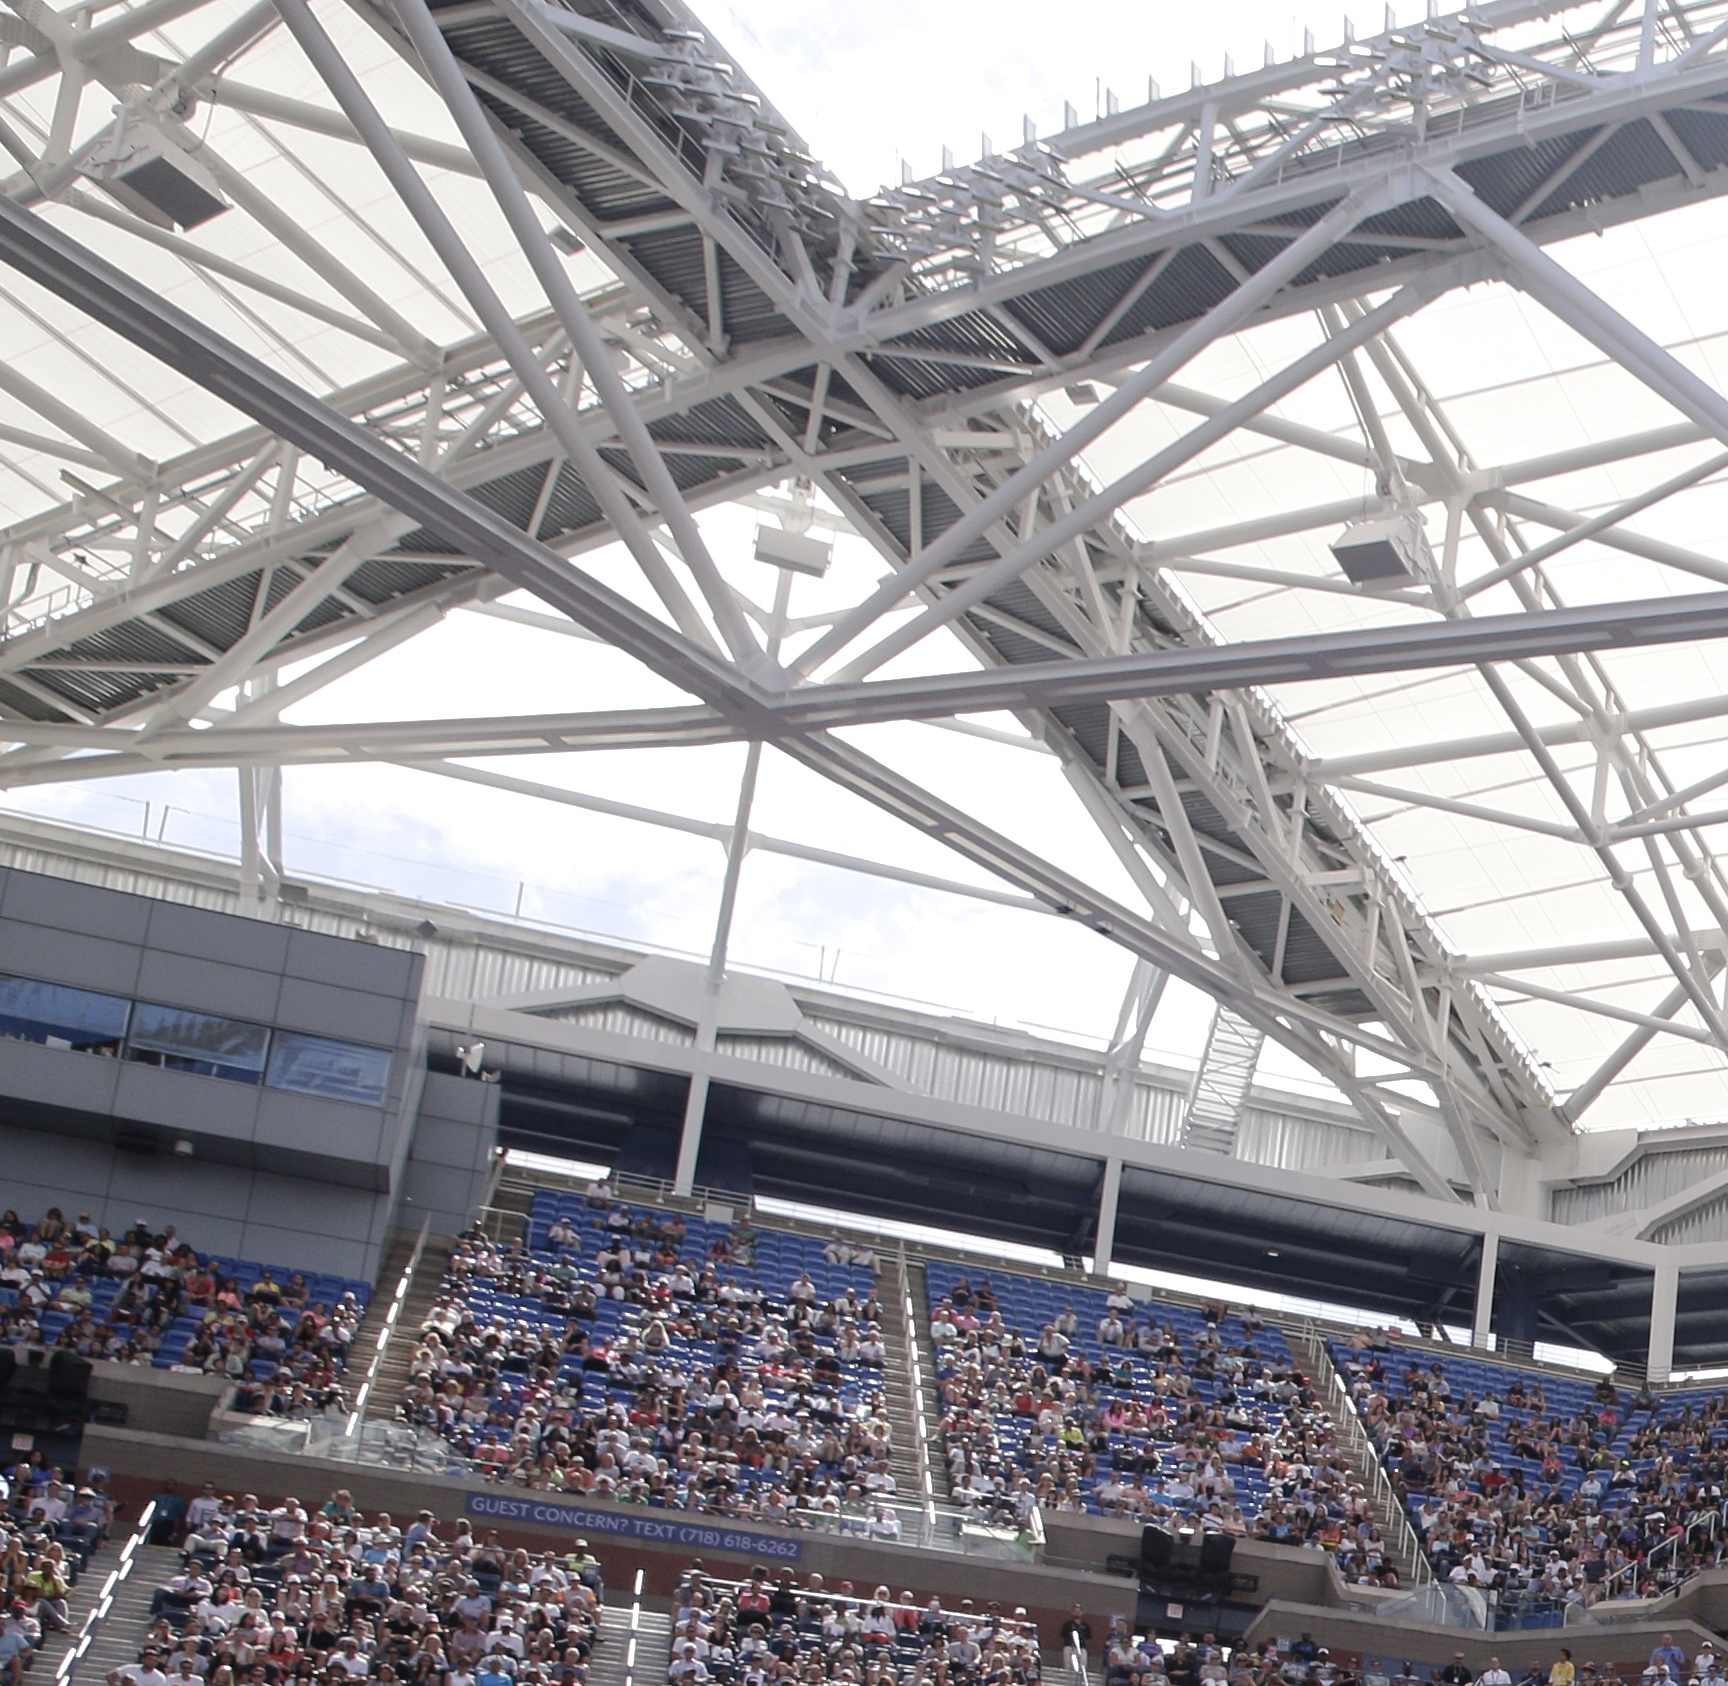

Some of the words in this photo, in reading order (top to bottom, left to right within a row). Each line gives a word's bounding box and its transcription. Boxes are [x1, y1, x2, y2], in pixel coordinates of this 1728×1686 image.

[472, 1497, 529, 1520] GUEST
[534, 1507, 629, 1532] CONCERN?
[634, 1520, 677, 1539] TEXT
[680, 1527, 720, 1547] (718)
[724, 1535, 797, 1557] 618-6262
